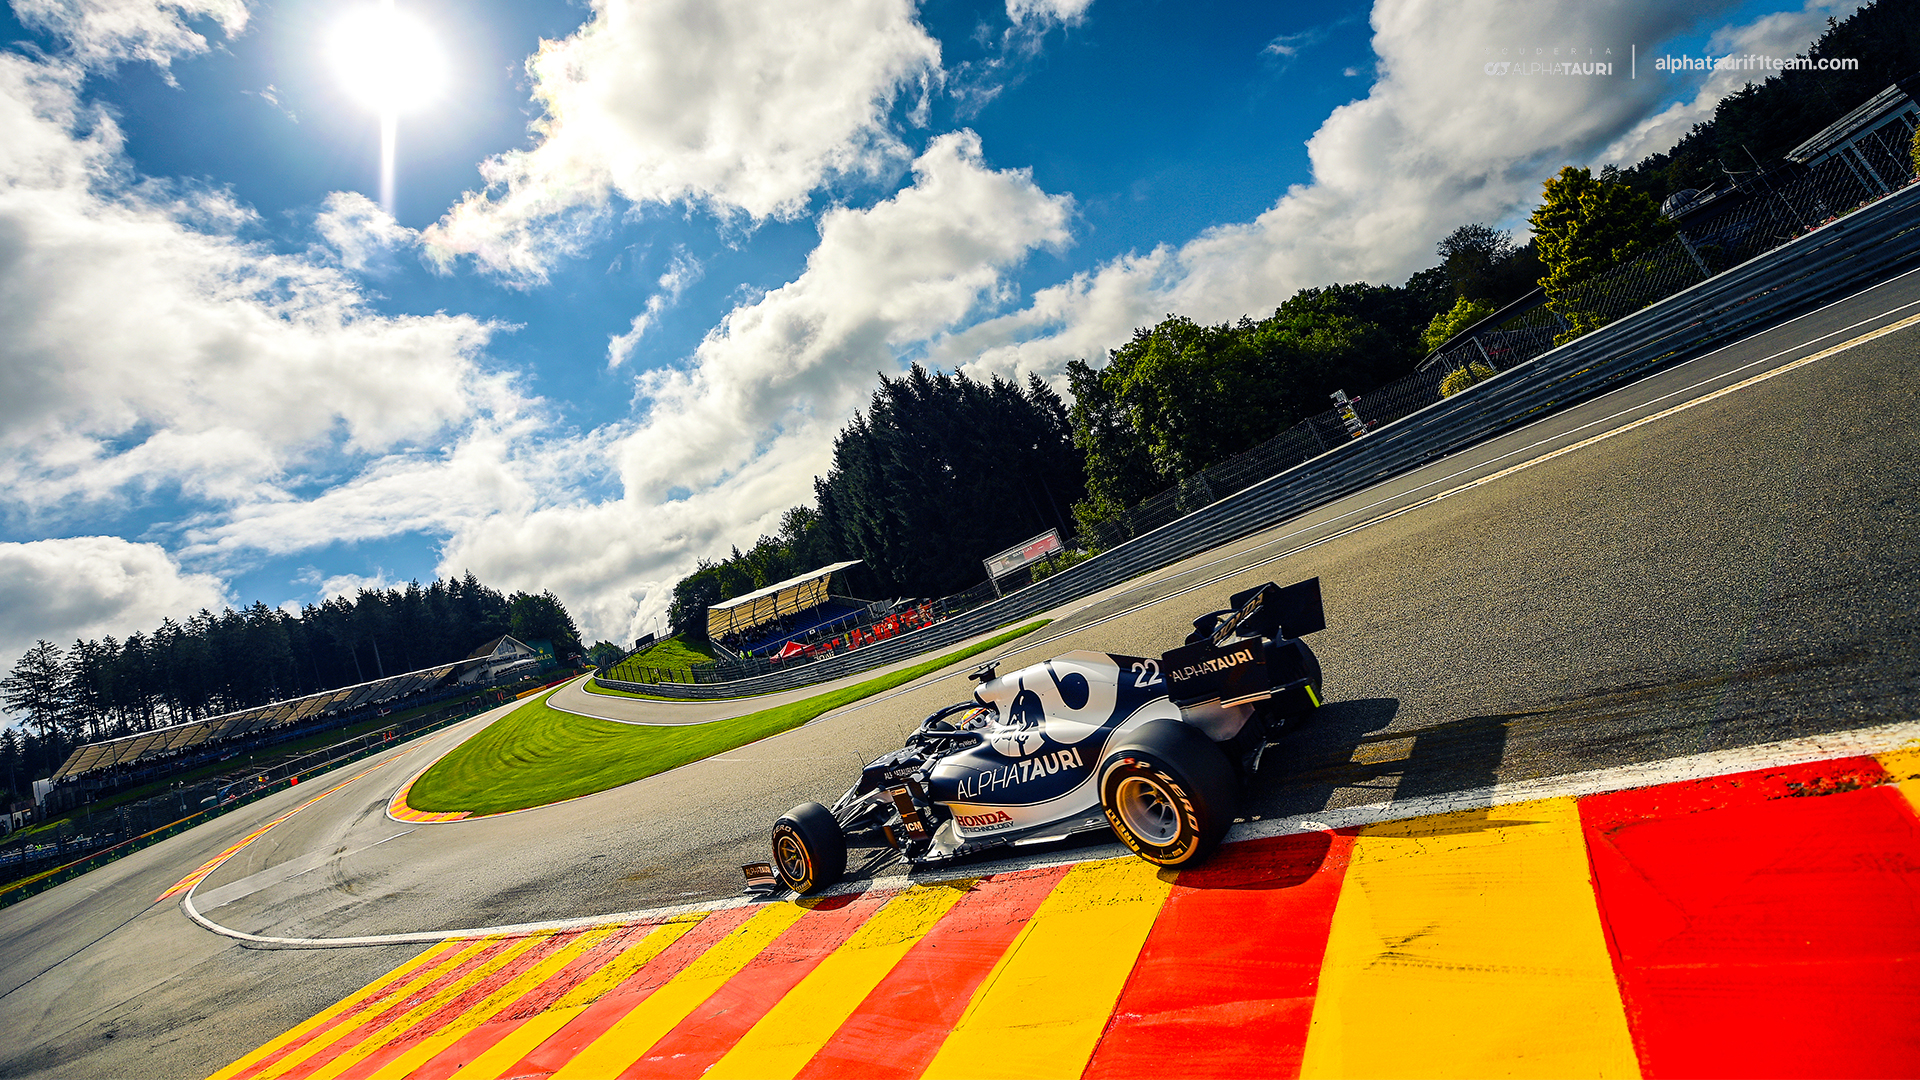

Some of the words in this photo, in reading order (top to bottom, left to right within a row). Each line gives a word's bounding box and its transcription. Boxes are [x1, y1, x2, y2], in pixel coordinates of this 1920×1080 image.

[1131, 658, 1162, 688] 22
[1172, 648, 1254, 682] ALPHATAURI
[957, 747, 1084, 800] ALPHATAURI
[1155, 770, 1200, 832] ZERO
[955, 810, 1013, 828] HONDA
